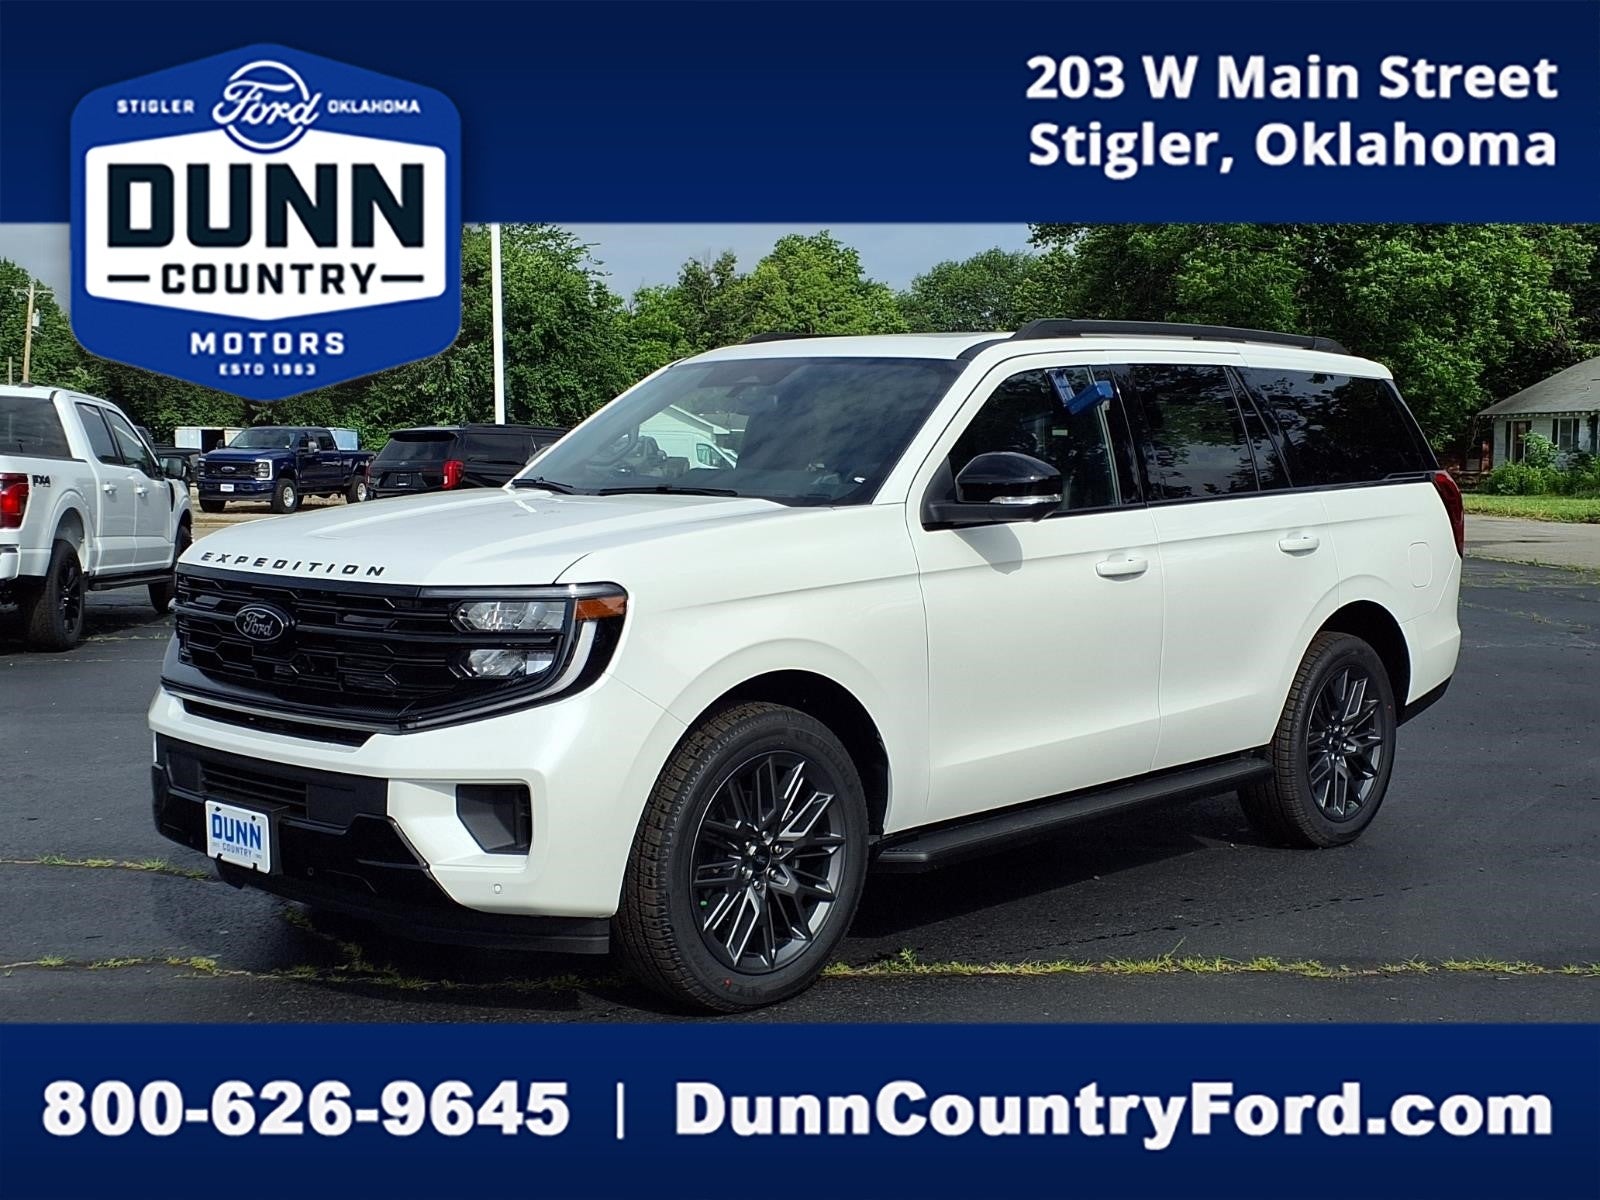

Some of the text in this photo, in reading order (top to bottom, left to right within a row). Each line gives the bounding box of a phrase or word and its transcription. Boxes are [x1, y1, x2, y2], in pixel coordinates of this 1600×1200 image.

[201, 552, 385, 577] EXPEDITION
[243, 611, 274, 636] Ford
[212, 814, 261, 850] DUNN
[223, 843, 252, 857] COUNTRY
